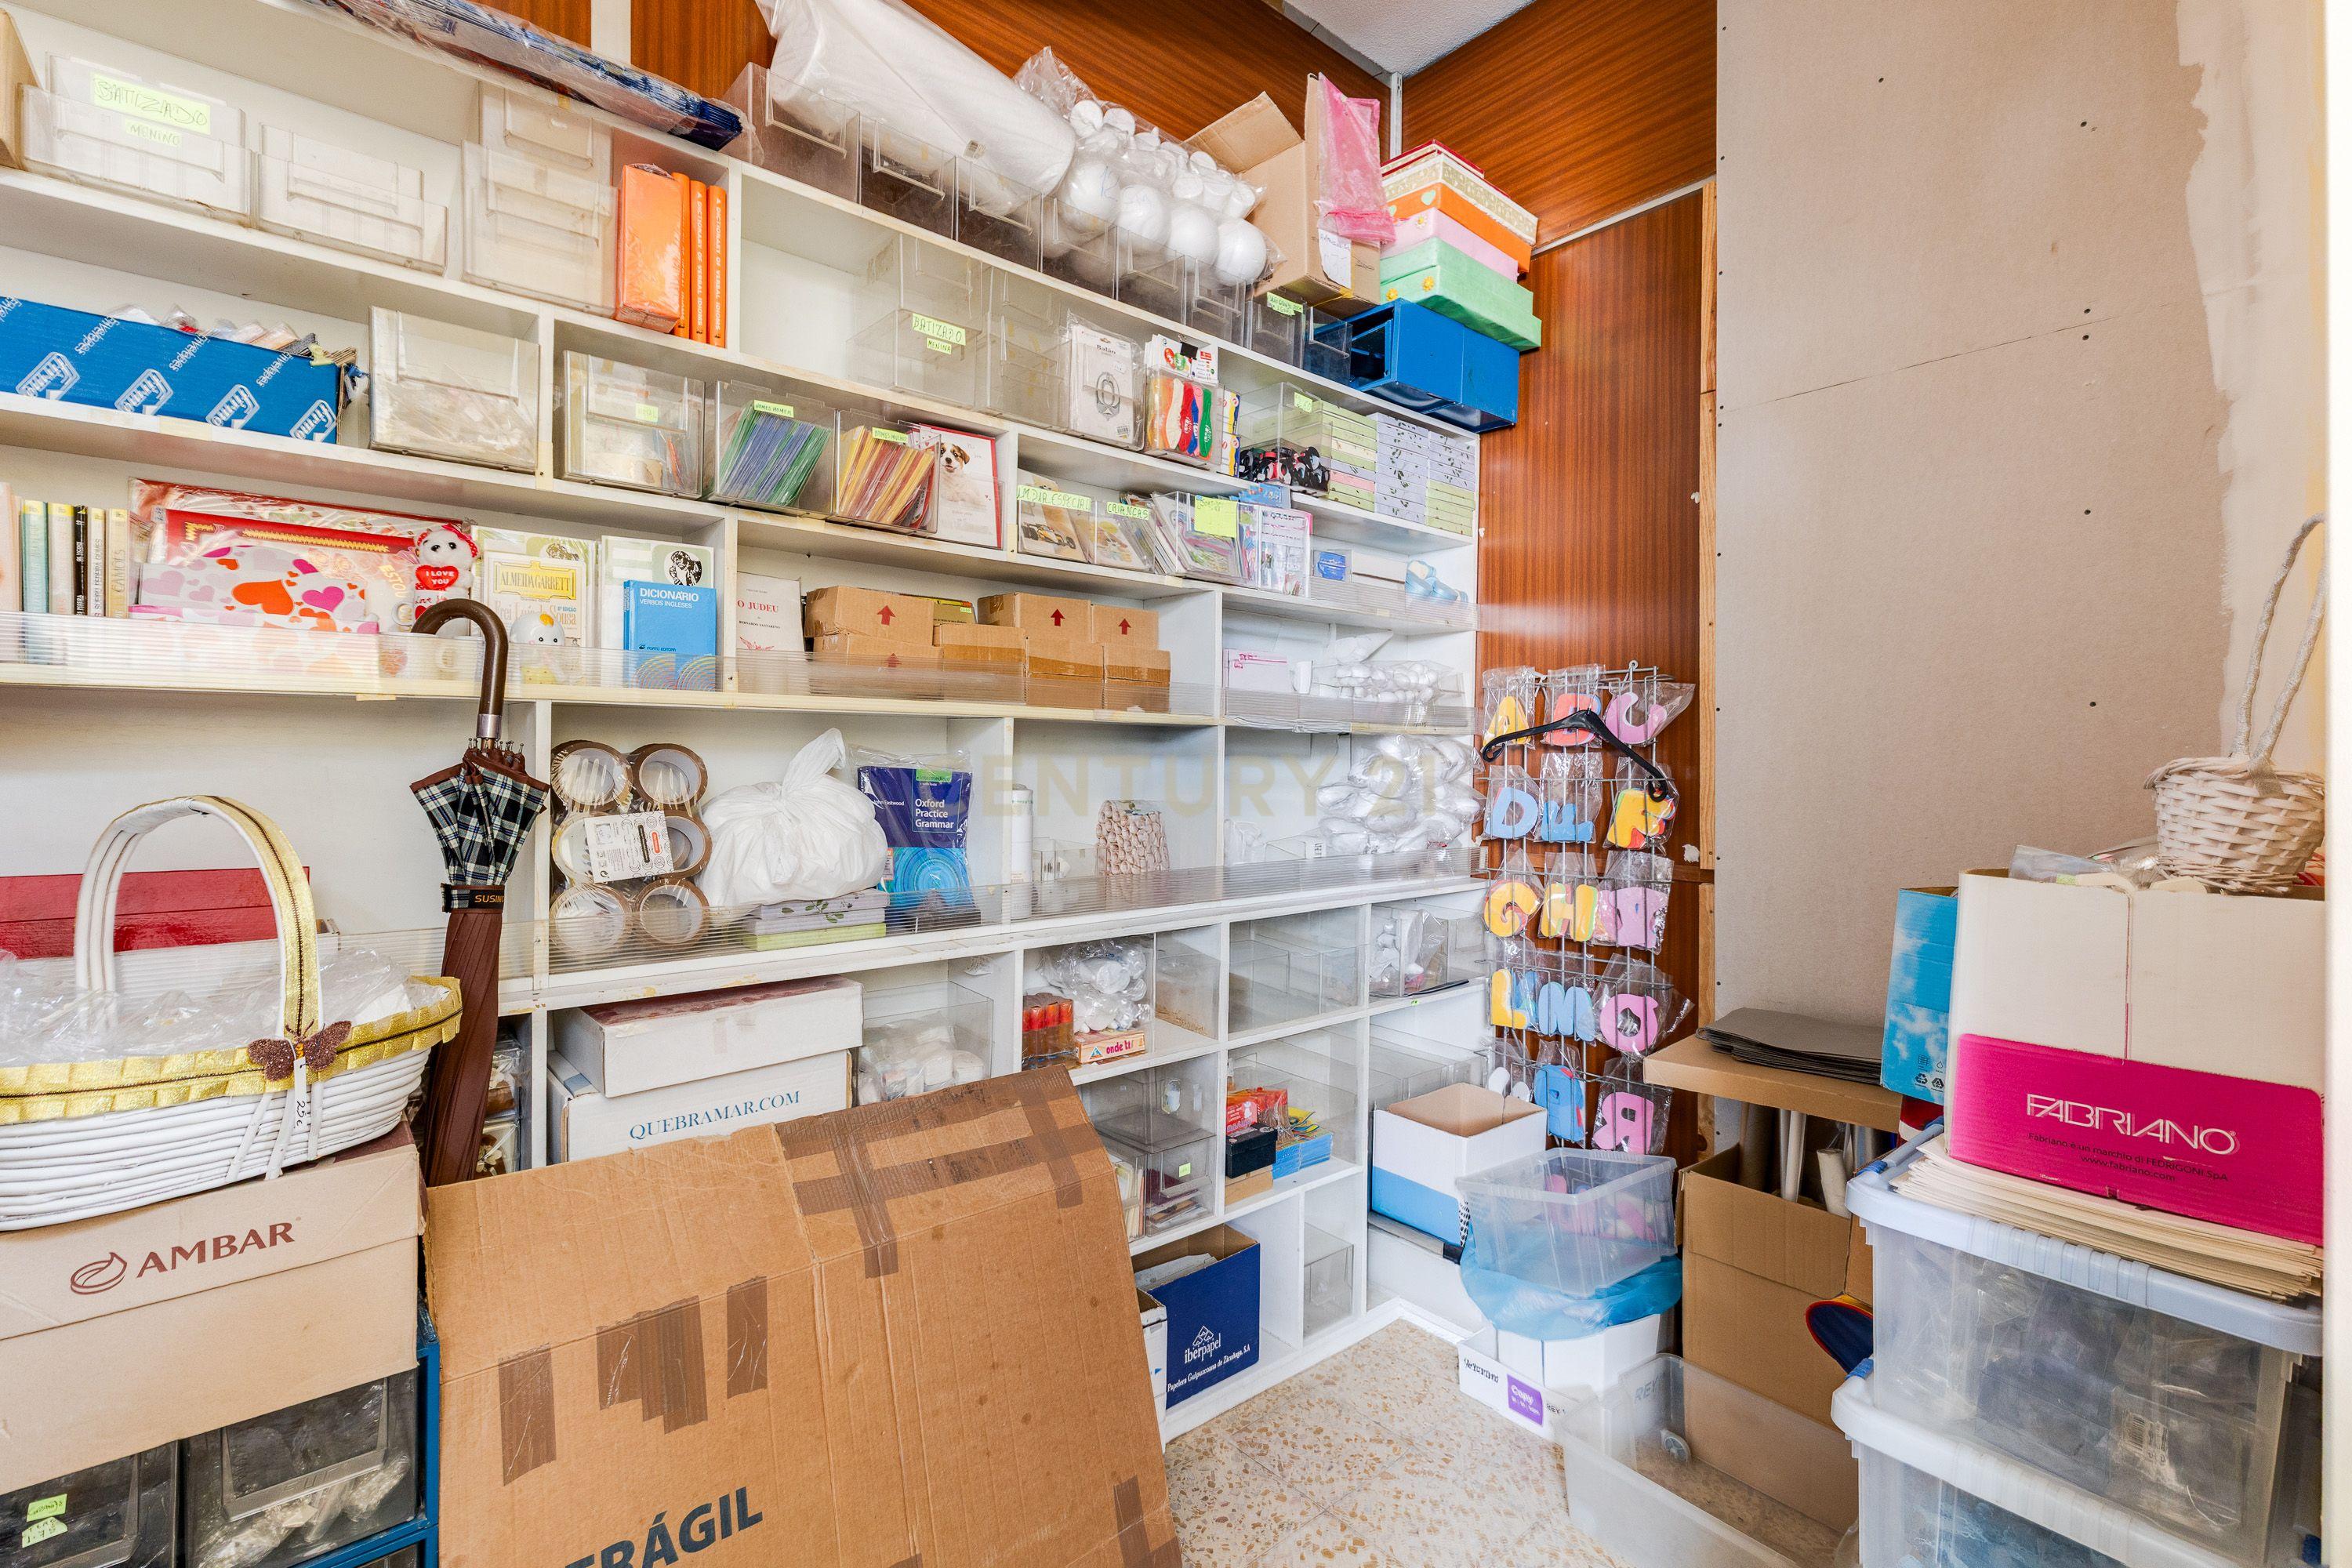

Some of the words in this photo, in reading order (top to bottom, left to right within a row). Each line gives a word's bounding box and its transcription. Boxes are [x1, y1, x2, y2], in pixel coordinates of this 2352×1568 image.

[502, 571, 534, 588] ALMEIDA
[535, 575, 570, 592] GARRETT
[640, 587, 699, 602] DICIONÁRIO
[664, 601, 692, 609] INGLESES
[737, 600, 745, 608] O
[748, 601, 779, 612] JUDEU
[915, 798, 945, 808] Oxford
[915, 808, 949, 818] Practice
[915, 819, 954, 829] Grammar
[1106, 1041, 1123, 1054] onde
[630, 1090, 800, 1141] QUEBRAMAR.COM
[2027, 1093, 2236, 1155] FABRIANO
[2028, 1132, 2068, 1148] Fabriano
[2092, 1146, 2132, 1161] marchio
[2146, 1157, 2204, 1176] FEDRIGONI
[2080, 1156, 2176, 1181] www.fabriano.com
[136, 1221, 296, 1279] AMBAR
[1184, 1333, 1221, 1364] iberpapel
[1167, 1377, 1187, 1392] Papelera
[1511, 1385, 1534, 1405] Copy
[564, 1486, 764, 1568] RÁGIL
